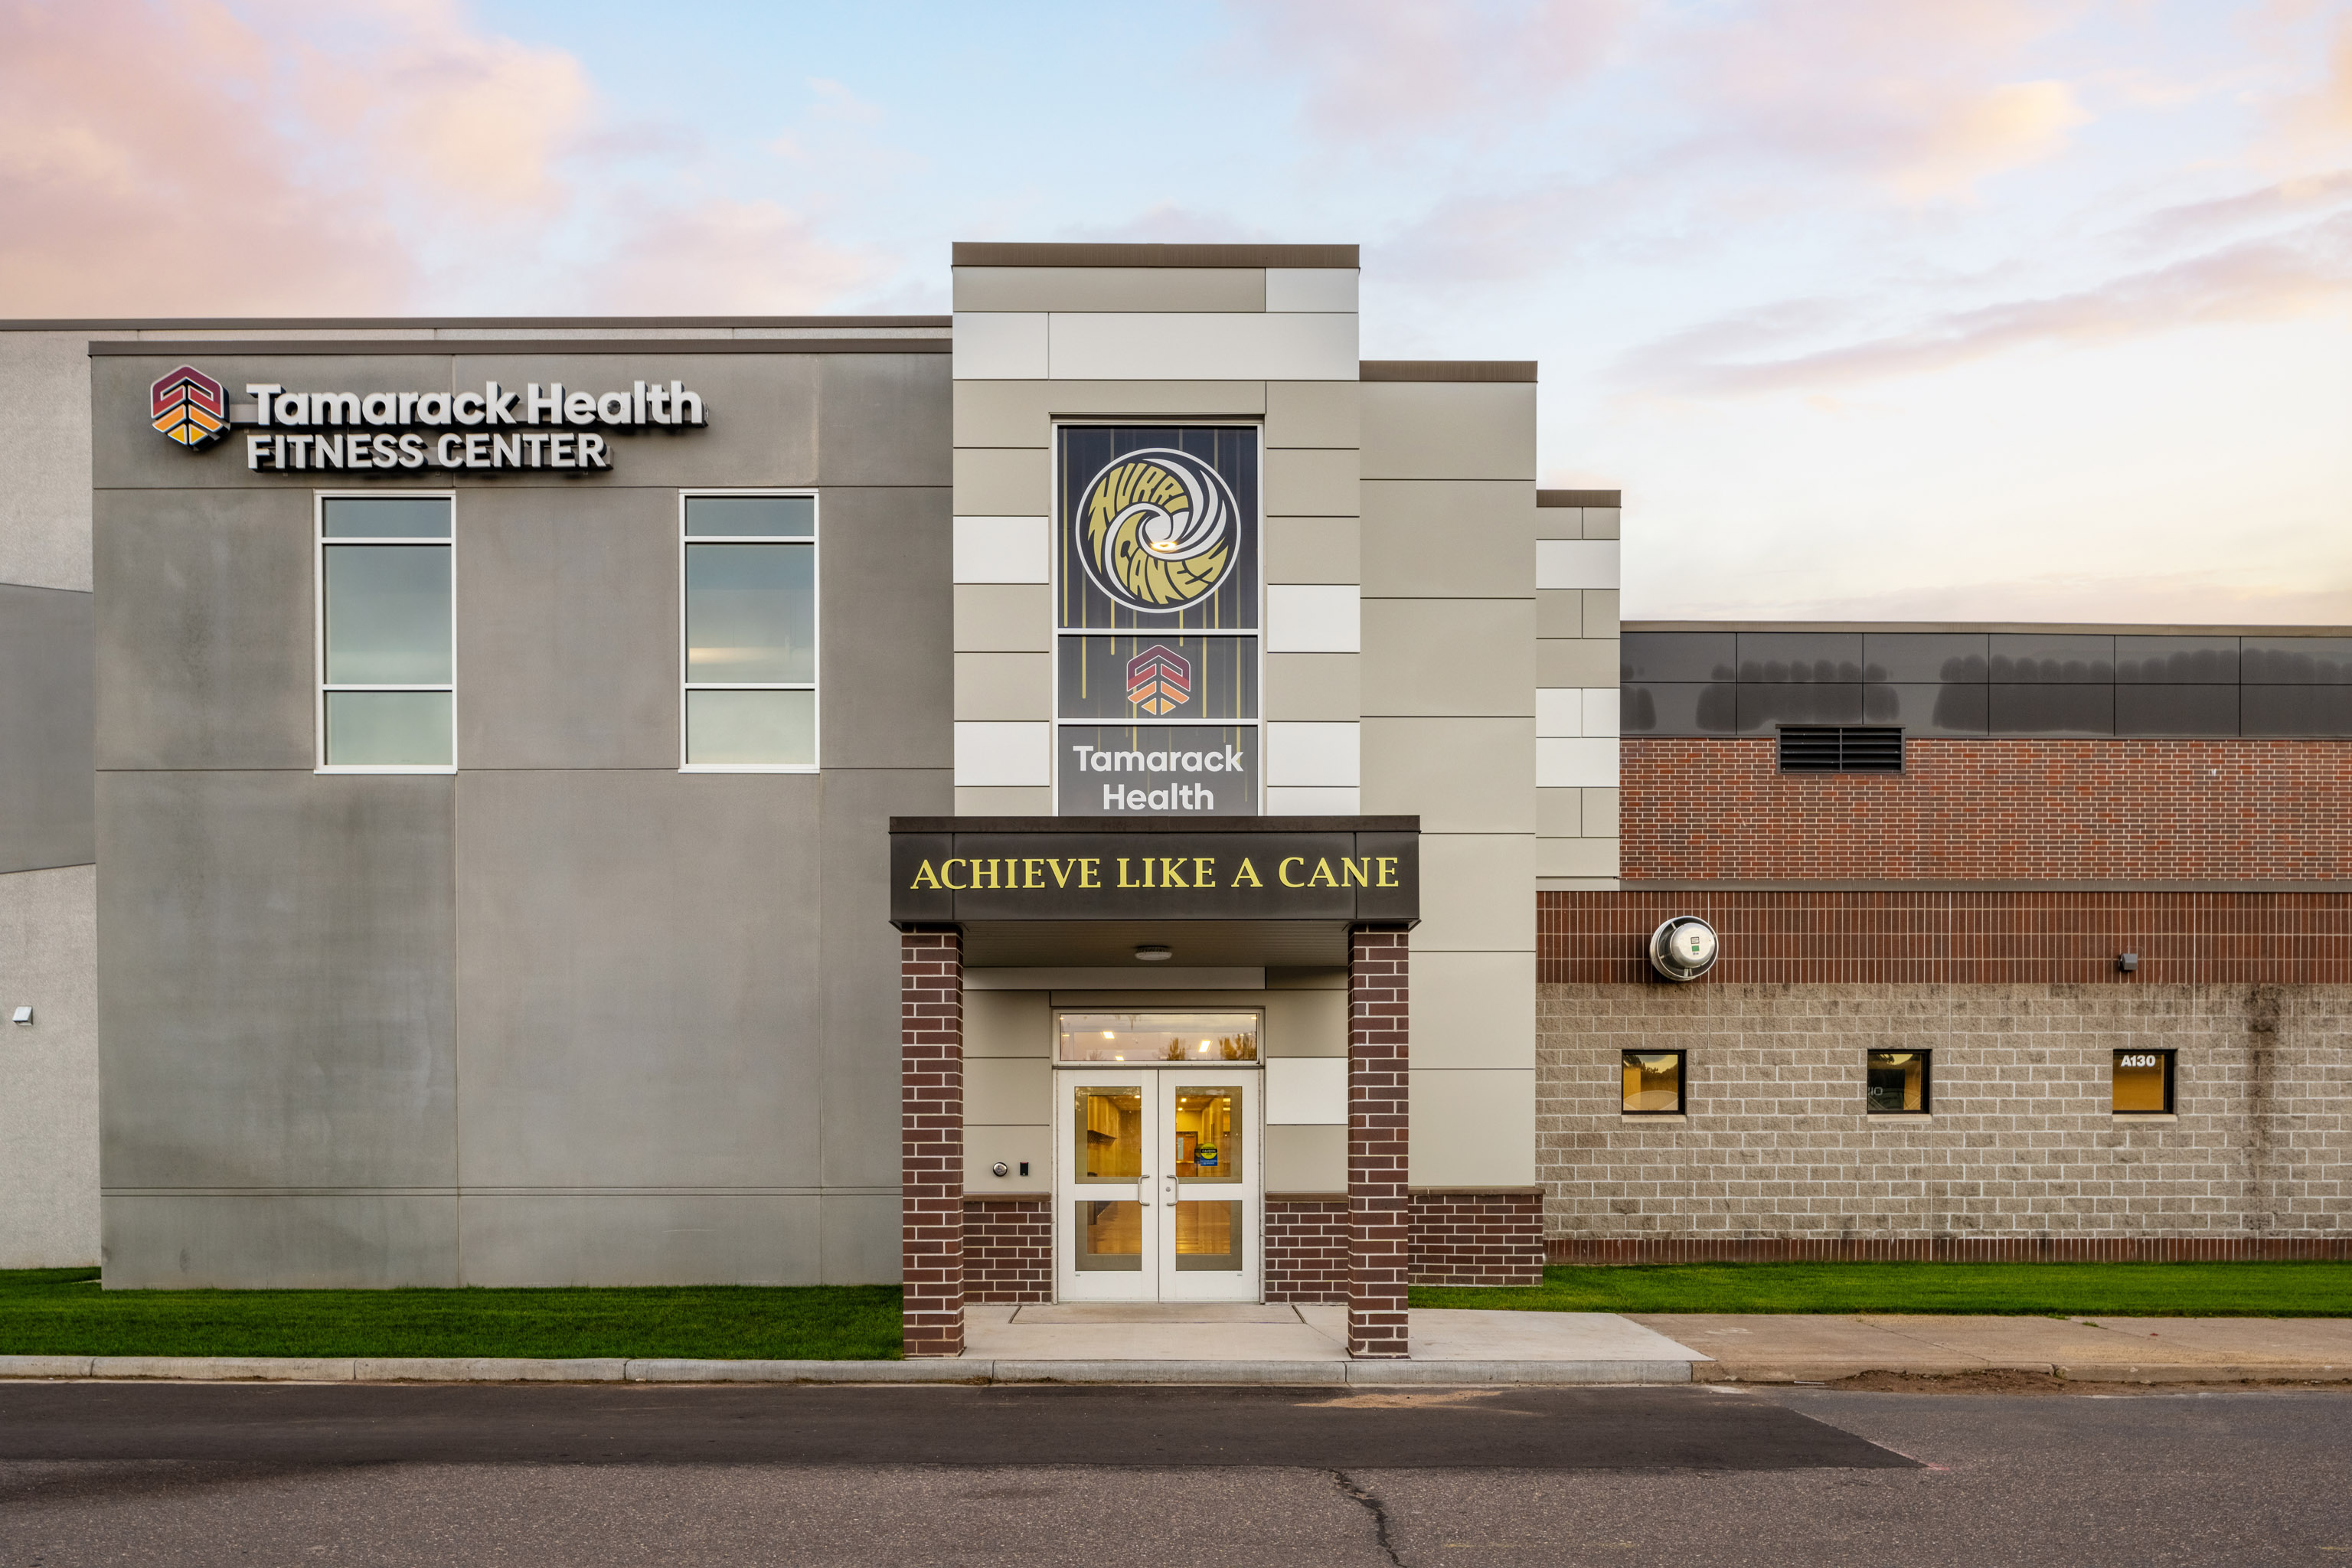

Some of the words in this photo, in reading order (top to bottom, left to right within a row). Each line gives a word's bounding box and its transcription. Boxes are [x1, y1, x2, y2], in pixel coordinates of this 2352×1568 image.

[246, 381, 516, 426] Tamarack
[528, 380, 704, 426] Health
[247, 433, 424, 469] FITNESS
[437, 433, 606, 469] CENTER
[1073, 744, 1244, 772] Tamarack
[1103, 782, 1214, 810] Health
[910, 858, 1101, 890] ACHIEVE
[1116, 858, 1216, 888] LIKE
[1230, 858, 1263, 887] A
[1279, 857, 1399, 888] CANE
[2121, 1055, 2156, 1067] A130
